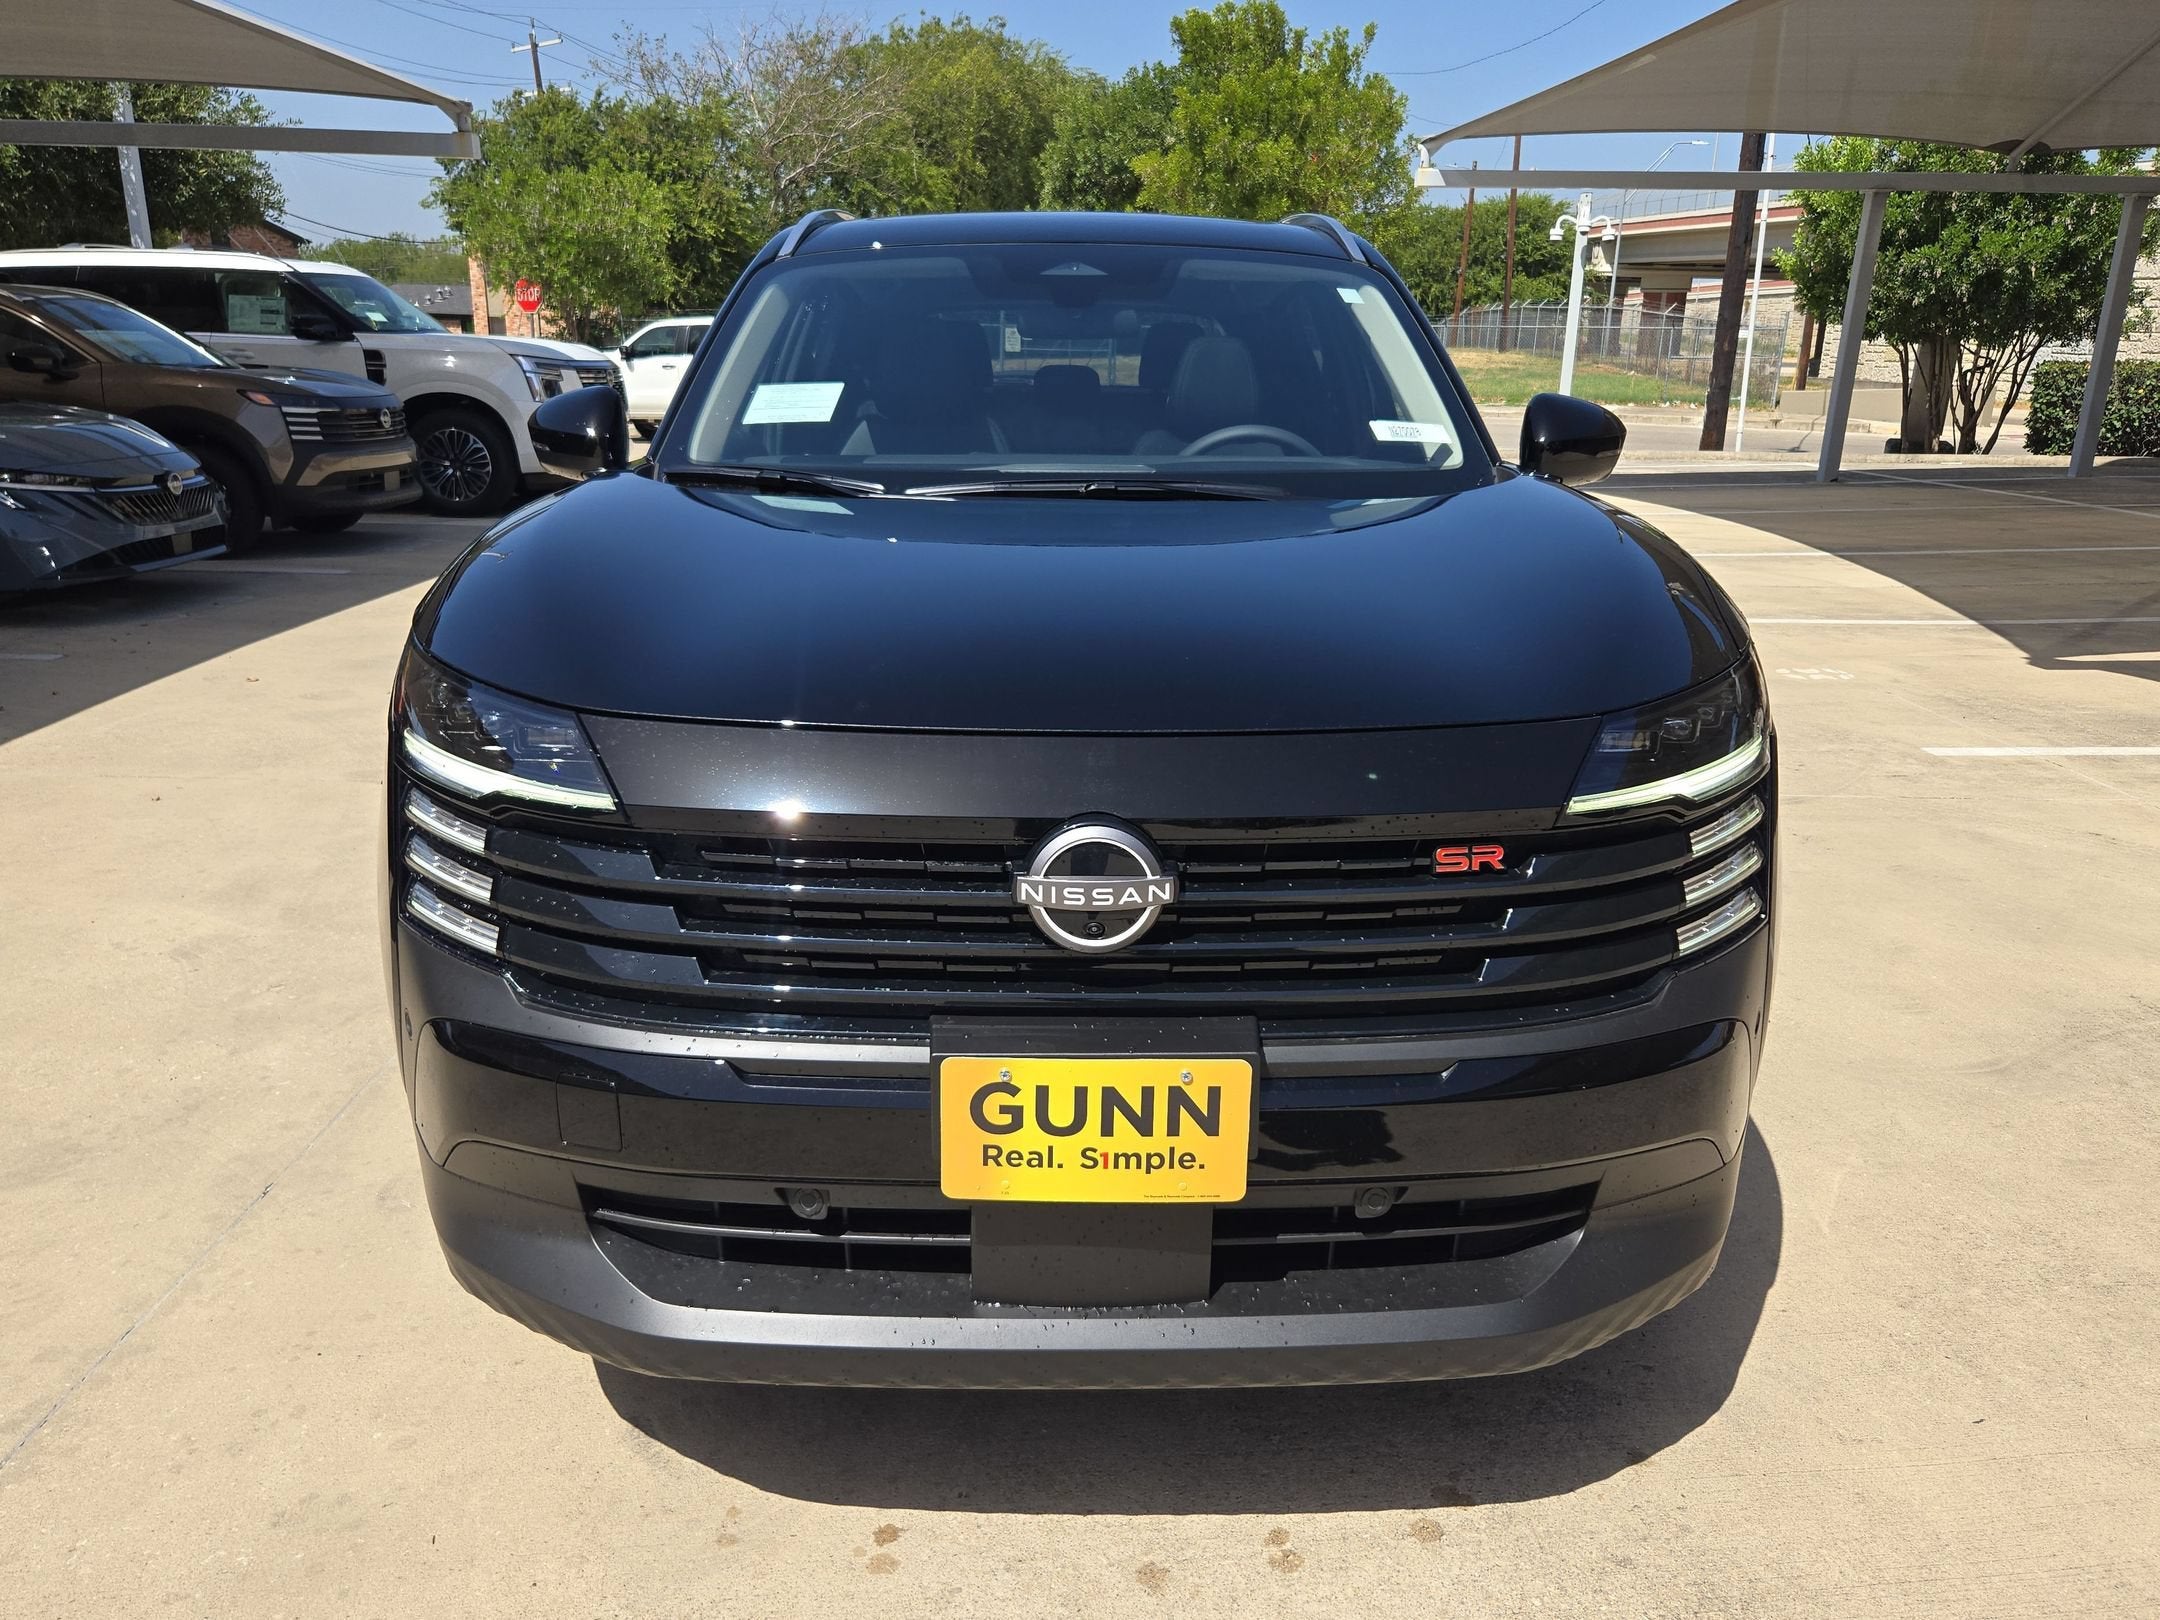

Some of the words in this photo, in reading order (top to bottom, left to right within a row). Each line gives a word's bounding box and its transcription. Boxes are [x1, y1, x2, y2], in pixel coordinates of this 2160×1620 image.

[517, 286, 541, 301] STOP
[1435, 844, 1504, 873] SR
[1020, 882, 1170, 906] NISSAN
[969, 1081, 1222, 1137] GUNN
[982, 1144, 1064, 1169] Real.
